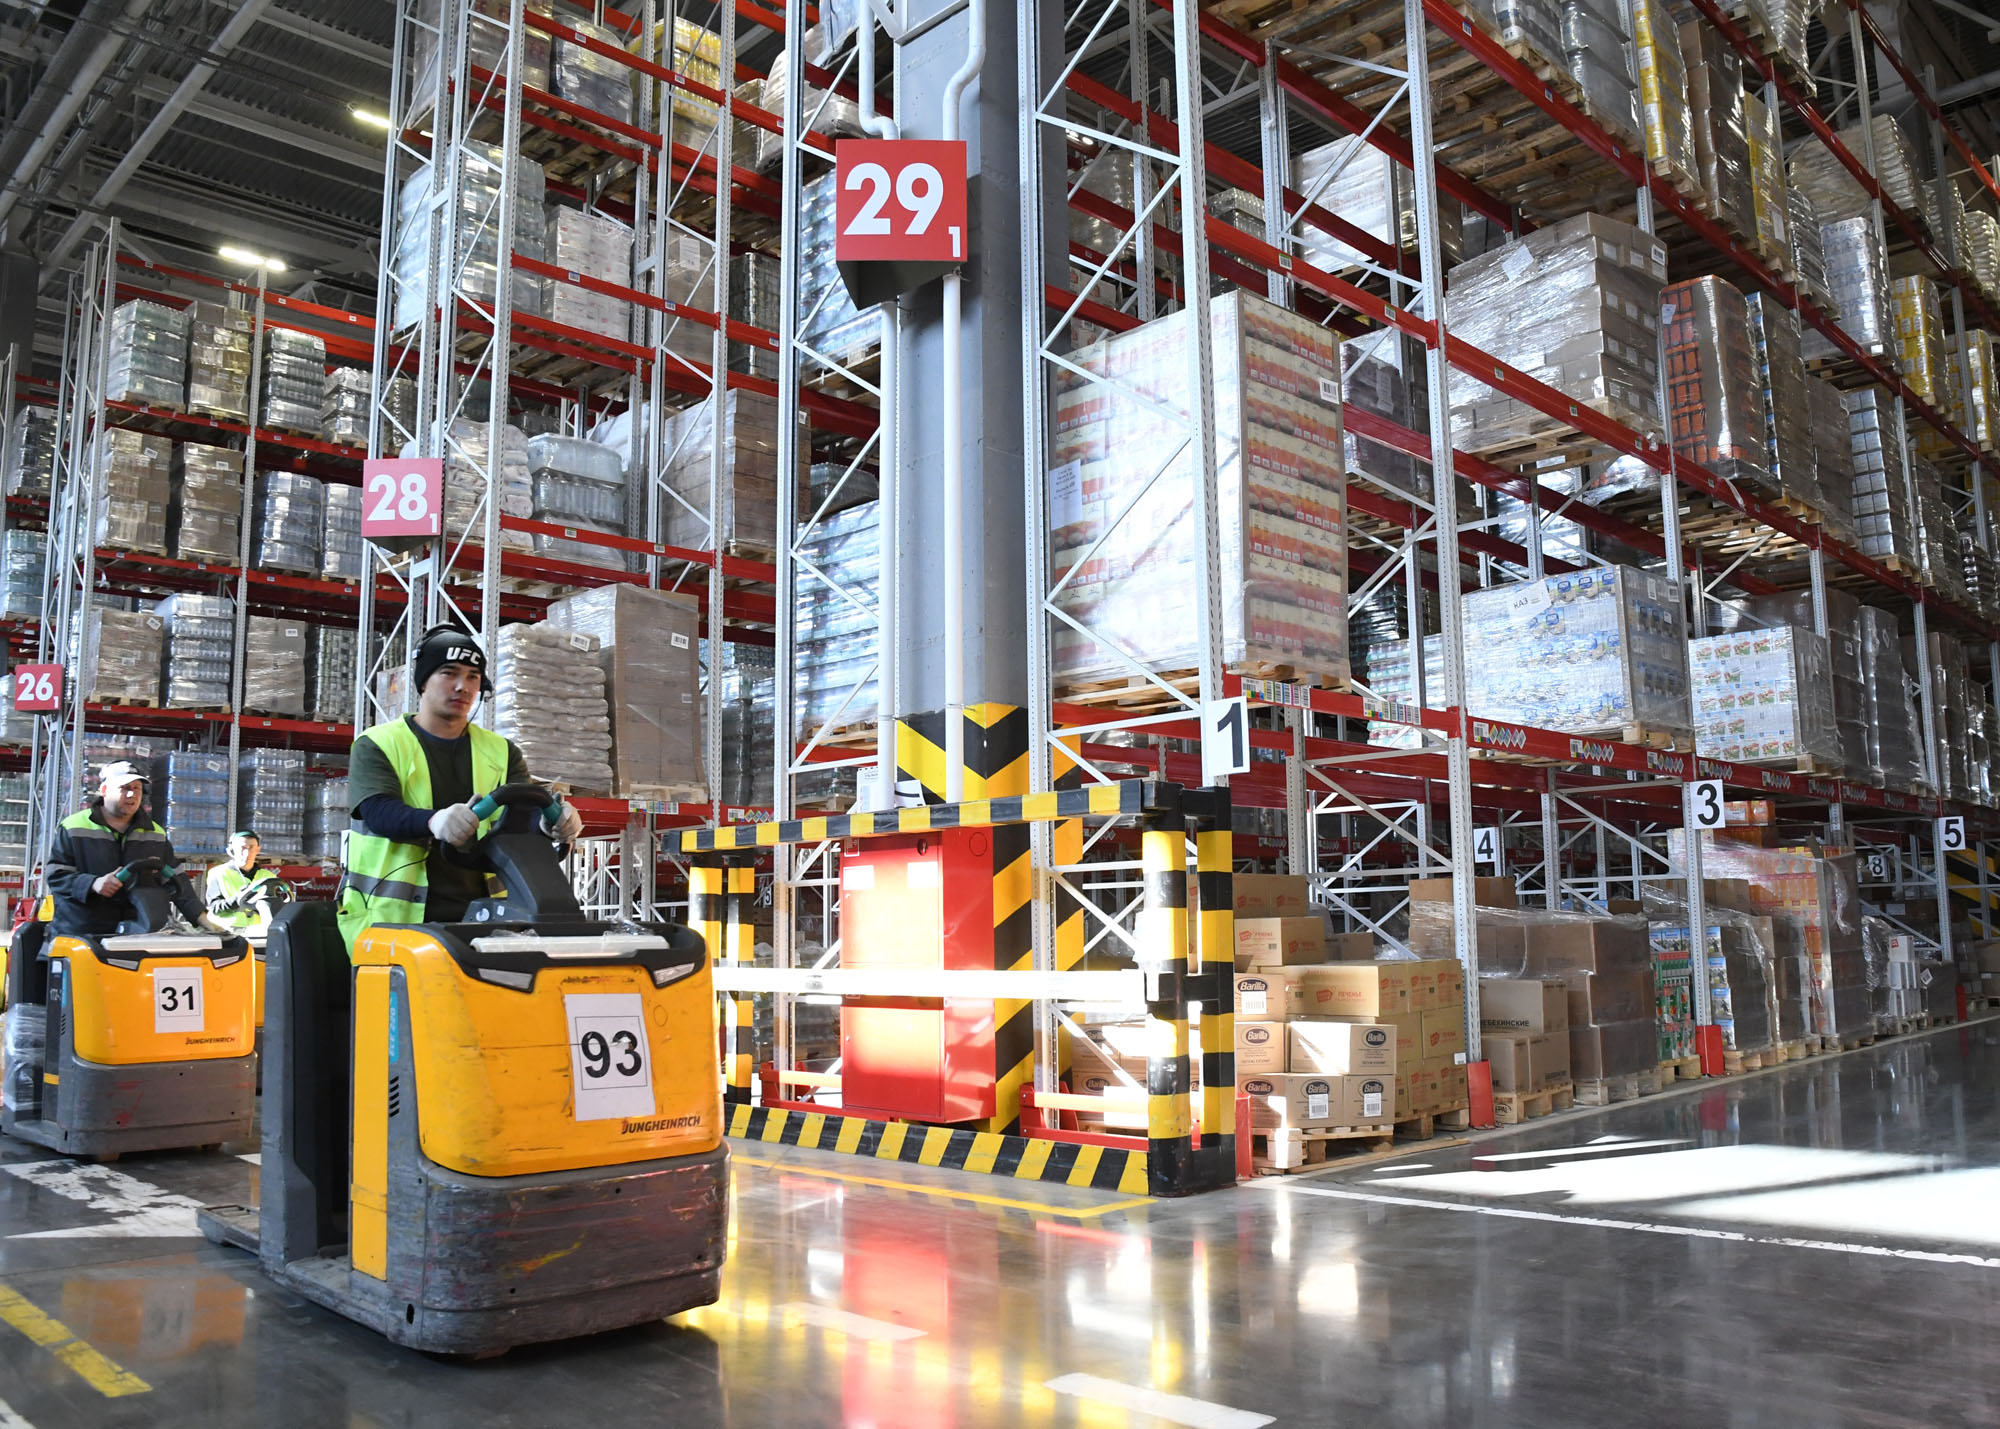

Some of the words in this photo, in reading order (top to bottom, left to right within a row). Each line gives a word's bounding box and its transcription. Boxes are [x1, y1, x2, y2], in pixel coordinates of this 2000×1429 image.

[843, 162, 944, 235] 29
[948, 226, 960, 258] 1
[367, 473, 428, 521] 28
[429, 513, 438, 533] 1
[446, 646, 481, 665] UFC
[17, 672, 53, 701] 26
[53, 696, 59, 709] 1
[1217, 702, 1243, 768] 1
[1697, 783, 1720, 825] 3
[1944, 819, 1962, 848] 5
[1478, 830, 1494, 859] 4
[1872, 856, 1883, 875] 8
[1239, 982, 1266, 991] Barilla
[161, 986, 194, 1011] 31
[185, 1037, 235, 1045] JUNGHEINRICH
[1247, 1031, 1268, 1040] Barilla
[1367, 1032, 1385, 1042] Barilla
[581, 1030, 643, 1078] 93
[1247, 1082, 1272, 1092] Barilla
[1307, 1083, 1329, 1094] Barilla
[1363, 1083, 1382, 1093] Barilla
[621, 1115, 701, 1135] JUNGHEINRICH
